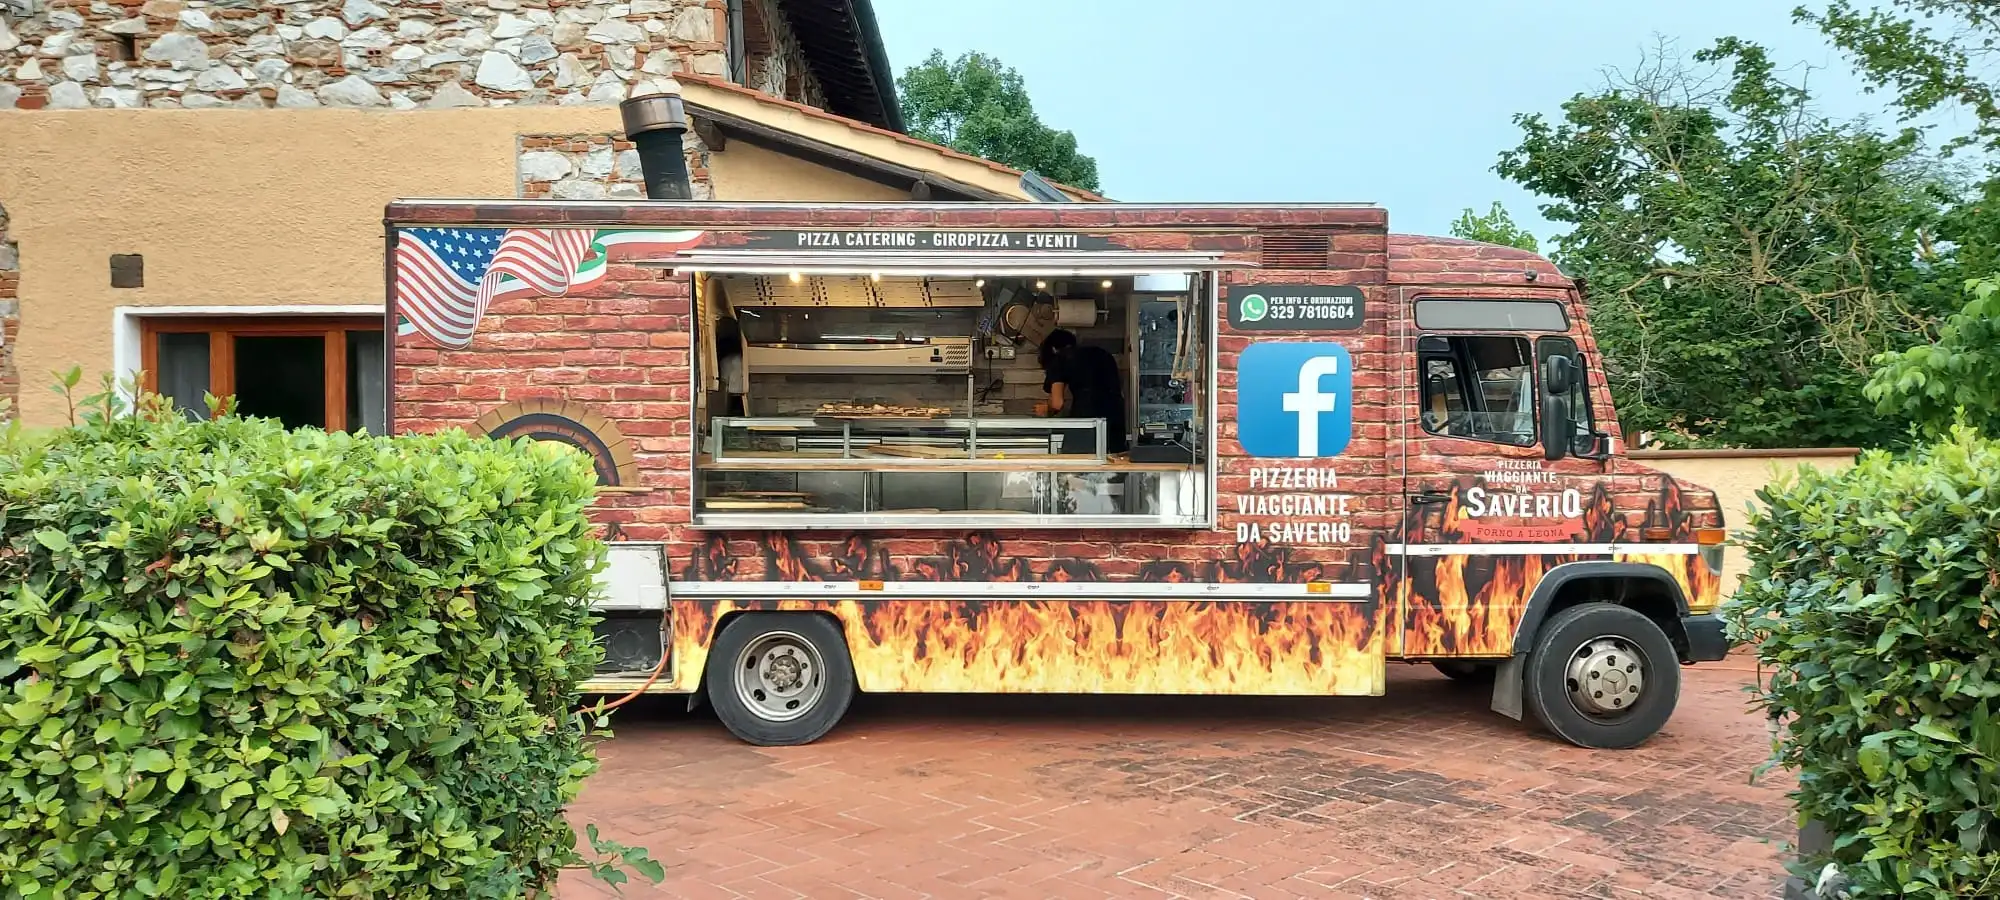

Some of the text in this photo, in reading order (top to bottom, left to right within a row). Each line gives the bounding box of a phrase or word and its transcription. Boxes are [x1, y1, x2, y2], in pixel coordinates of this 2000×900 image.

[798, 232, 1078, 248] PIZZA CATERING GIROPIZZA EVENTI
[1270, 296, 1353, 305] PER INFO E ORDINAZIONI
[1270, 305, 1354, 319] 329 7810604
[1498, 460, 1542, 470] PIZZERIA
[1249, 467, 1338, 488] PIZZERIA
[1484, 470, 1557, 484] VIAGGIANTE
[1237, 494, 1351, 516] VIAGGIANTE
[1467, 487, 1584, 518] SAVERIO
[1237, 522, 1351, 543] DA SAVERIO
[1477, 528, 1513, 538] FORNO
[1518, 530, 1524, 538] A
